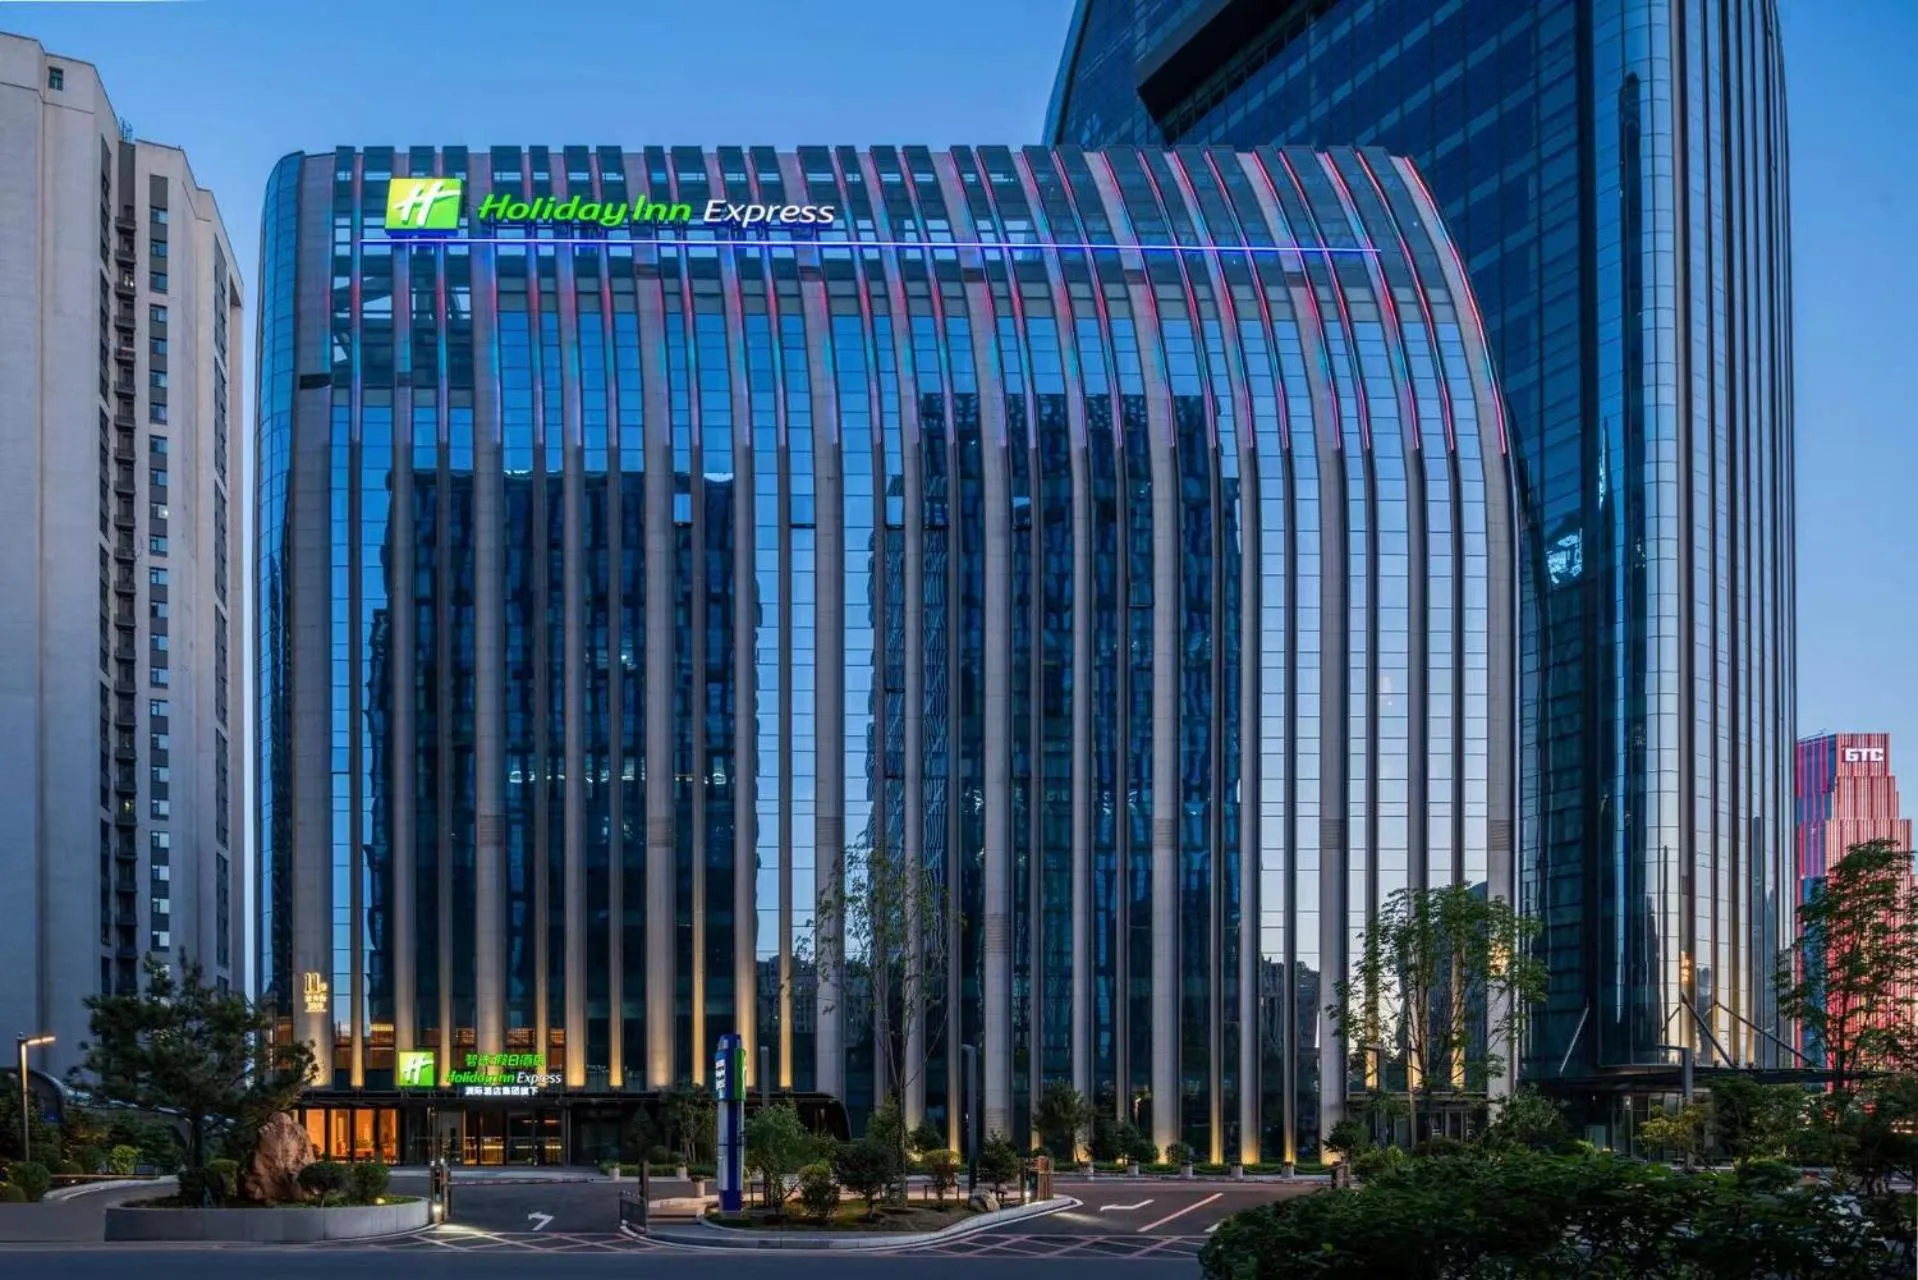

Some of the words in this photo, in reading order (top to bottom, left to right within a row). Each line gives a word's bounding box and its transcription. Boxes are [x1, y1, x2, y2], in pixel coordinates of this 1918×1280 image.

[478, 193, 628, 227] Holiday
[632, 194, 693, 222] Inn
[703, 199, 835, 228] Express
[445, 1069, 493, 1086] Holiday
[516, 1071, 562, 1085] Express
